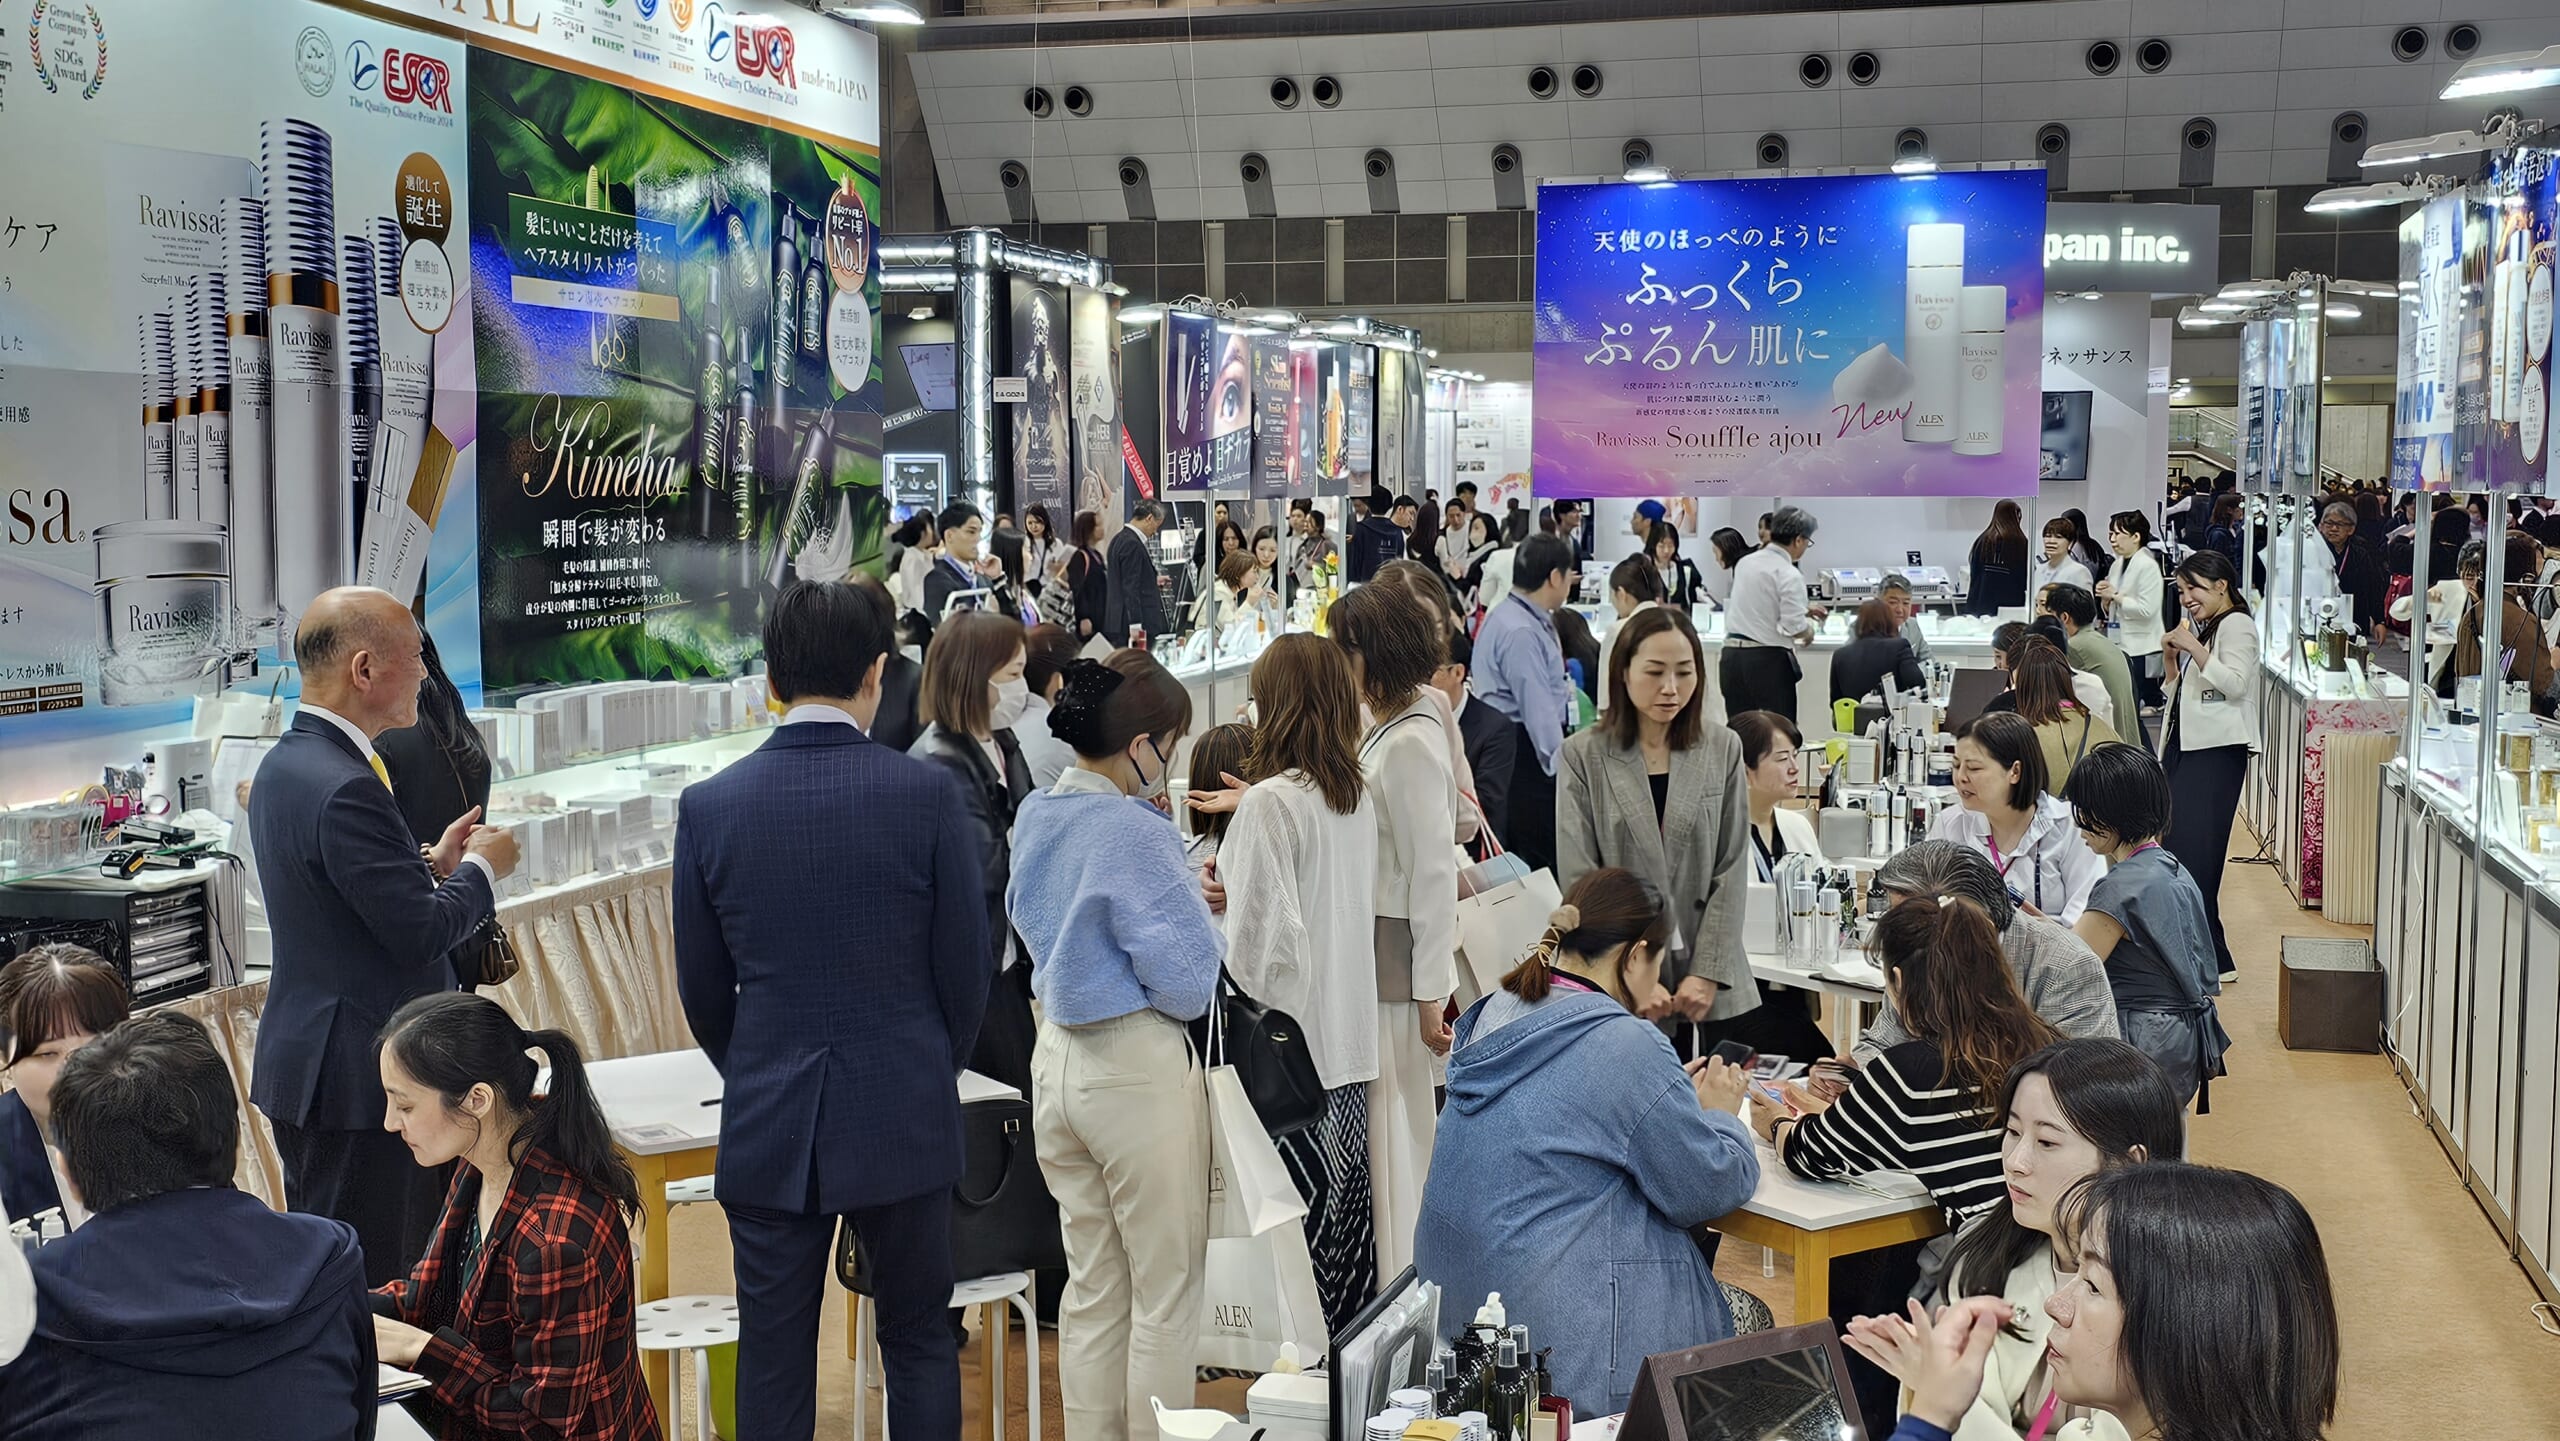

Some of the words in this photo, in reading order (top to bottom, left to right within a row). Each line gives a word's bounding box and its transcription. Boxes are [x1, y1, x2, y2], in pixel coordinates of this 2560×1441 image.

[54, 48, 84, 66] SDGs
[53, 63, 87, 82] Award
[384, 48, 453, 114] ESQR
[744, 79, 767, 97] Choice
[349, 96, 363, 108] The
[365, 101, 391, 118] Quality
[393, 105, 417, 121] Choice
[405, 174, 441, 195] 進化して
[139, 194, 221, 235] Ravissa
[405, 195, 444, 229] 誕生
[525, 211, 663, 255] 髪にいいことだけを考えて
[1593, 223, 1838, 253] 天使のほっぺのように
[2120, 226, 2190, 263] inc.
[524, 247, 666, 284] ヘアスタイリストがつくった
[832, 234, 865, 274] No.1
[1626, 257, 1803, 312] ふっくら
[1914, 294, 1955, 305] Ravissa
[281, 322, 332, 350] Ravissa
[382, 352, 429, 377] Ravissa
[1961, 346, 1998, 357] Ravissa
[2042, 346, 2134, 366] ネッサンス
[1831, 400, 1913, 439] New
[1918, 415, 1944, 424] ALEN
[1665, 425, 1760, 449] Souffle
[1769, 425, 1822, 456] ajou
[1966, 432, 1989, 440] ALEN
[543, 516, 666, 549] 瞬間で髪が変わる
[129, 602, 200, 633] Ravissa
[1215, 1304, 1253, 1328] ALEN
